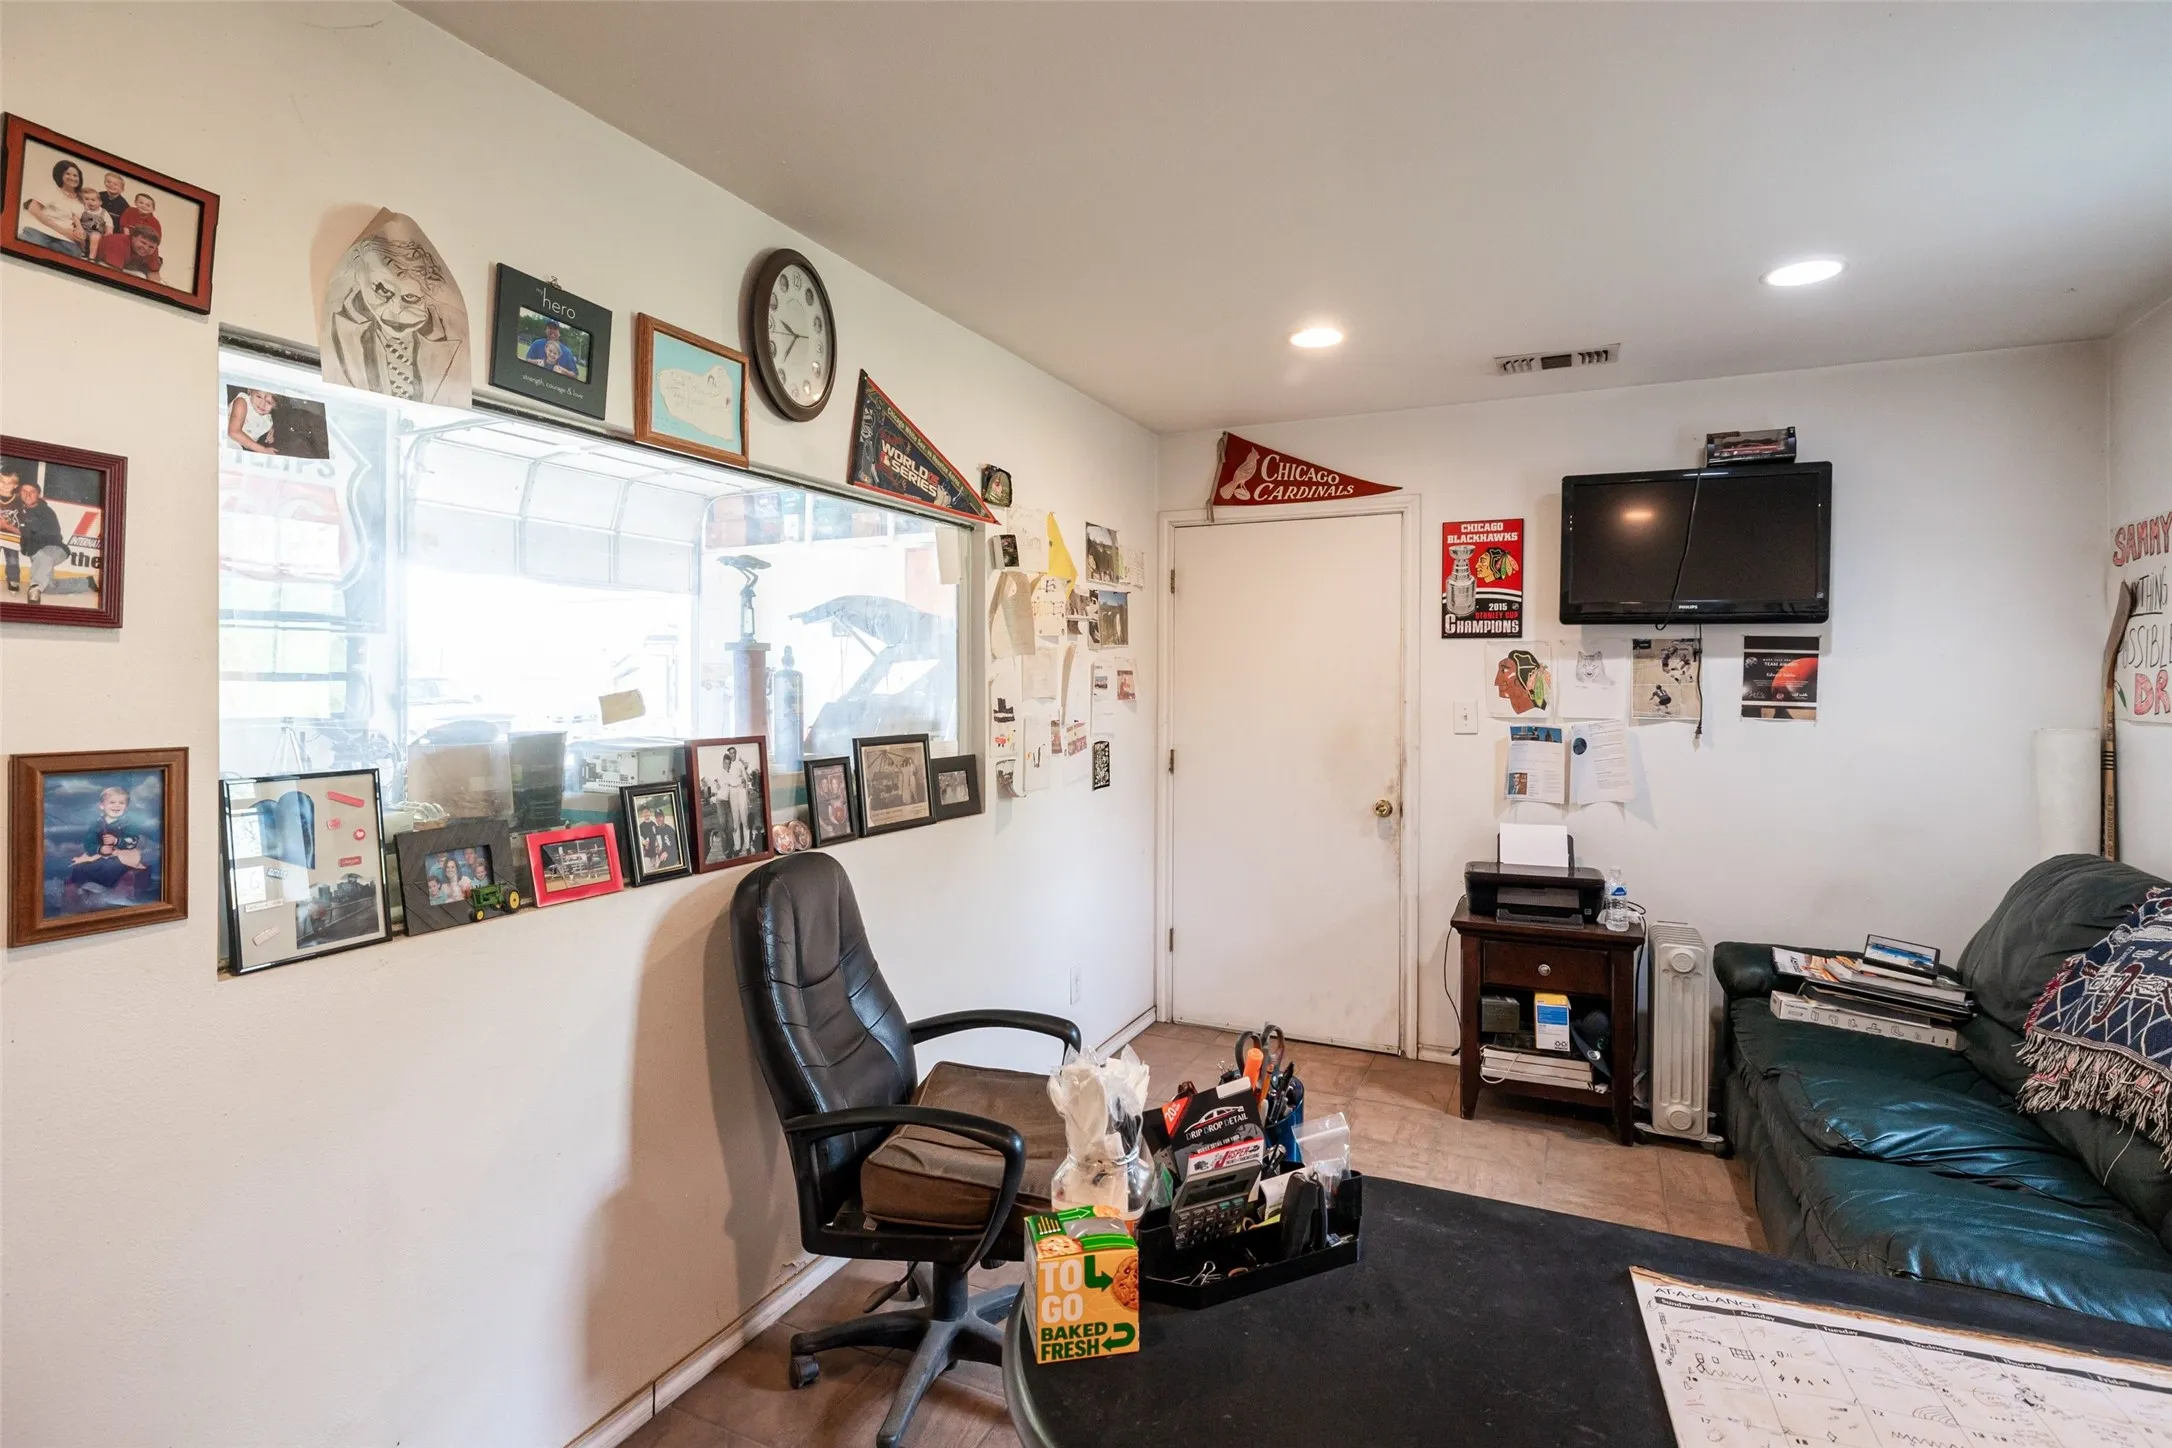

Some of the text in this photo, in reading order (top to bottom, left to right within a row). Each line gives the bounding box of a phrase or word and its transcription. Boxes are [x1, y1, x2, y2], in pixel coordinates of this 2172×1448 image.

[542, 287, 576, 319] hero
[545, 382, 566, 395] courage
[573, 388, 584, 399] love
[880, 439, 929, 480] WORLD
[1261, 454, 1340, 485] CHICAGO
[891, 461, 939, 499] SERIES
[1253, 482, 1354, 501] CARDINALS
[1461, 522, 1504, 533] CHICAGO
[1446, 532, 1519, 544] BLACKHAWKS
[2112, 511, 2172, 567] SAMMY
[71, 551, 102, 569] the
[2131, 566, 2168, 612] YTHING
[1474, 611, 1519, 620] STANLEY CUP
[1488, 603, 1508, 611] 2015
[1444, 614, 1520, 634] CHAMPIONS
[1164, 1104, 1178, 1122] 20
[1186, 1113, 1248, 1141] DRIP DROP DETAIL
[1214, 1146, 1251, 1169] JASPER
[1039, 1258, 1083, 1293] TO
[1041, 1293, 1084, 1323] GO
[1661, 1298, 1691, 1309] Sunday
[1740, 1311, 1776, 1322] Monday
[1041, 1322, 1108, 1342] BAKED
[1822, 1326, 1859, 1336] Tuesday
[1041, 1338, 1100, 1361] FRESH
[1910, 1341, 1965, 1356] Wednesday
[2003, 1358, 2047, 1371] Thursday
[2097, 1375, 2131, 1388] Friday
[1872, 1409, 1885, 1417] 12
